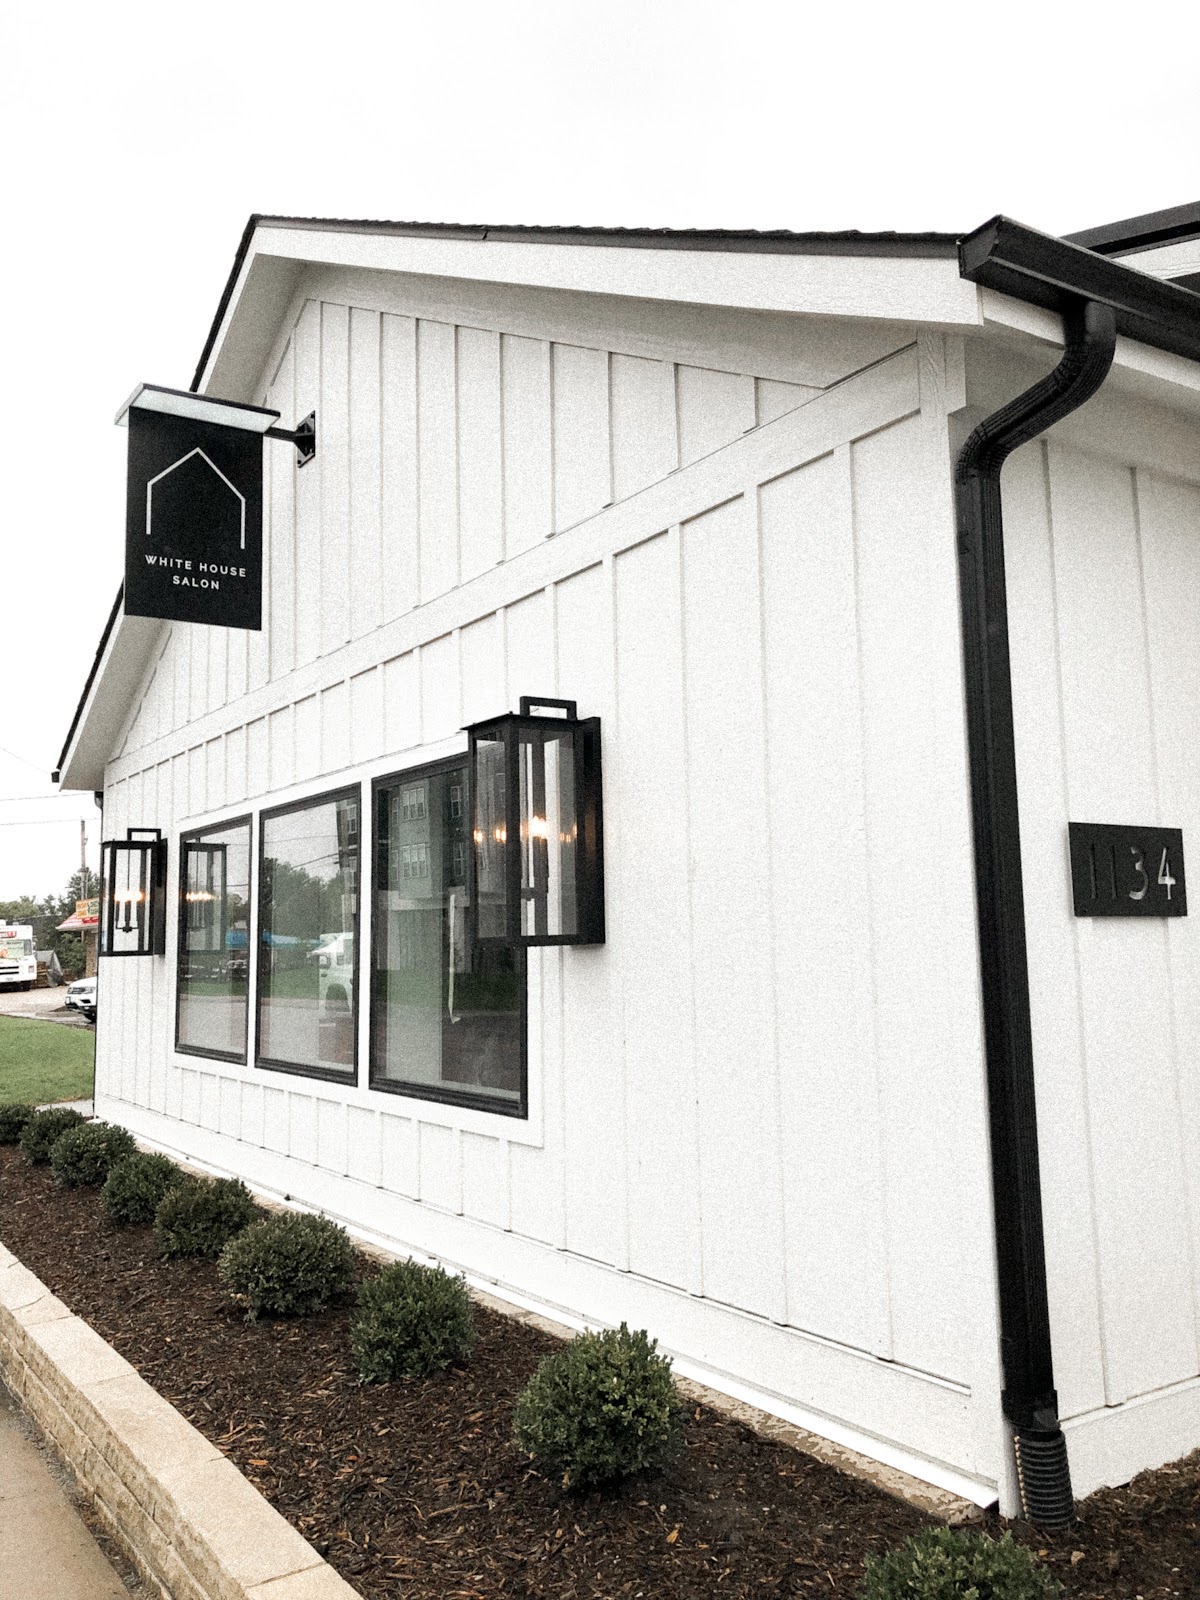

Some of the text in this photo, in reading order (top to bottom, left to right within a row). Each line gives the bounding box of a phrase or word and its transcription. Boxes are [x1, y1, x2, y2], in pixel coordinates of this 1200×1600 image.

[145, 554, 246, 577] WHITE HOUSE
[172, 575, 219, 590] SALON
[1089, 843, 1176, 900] 1134
